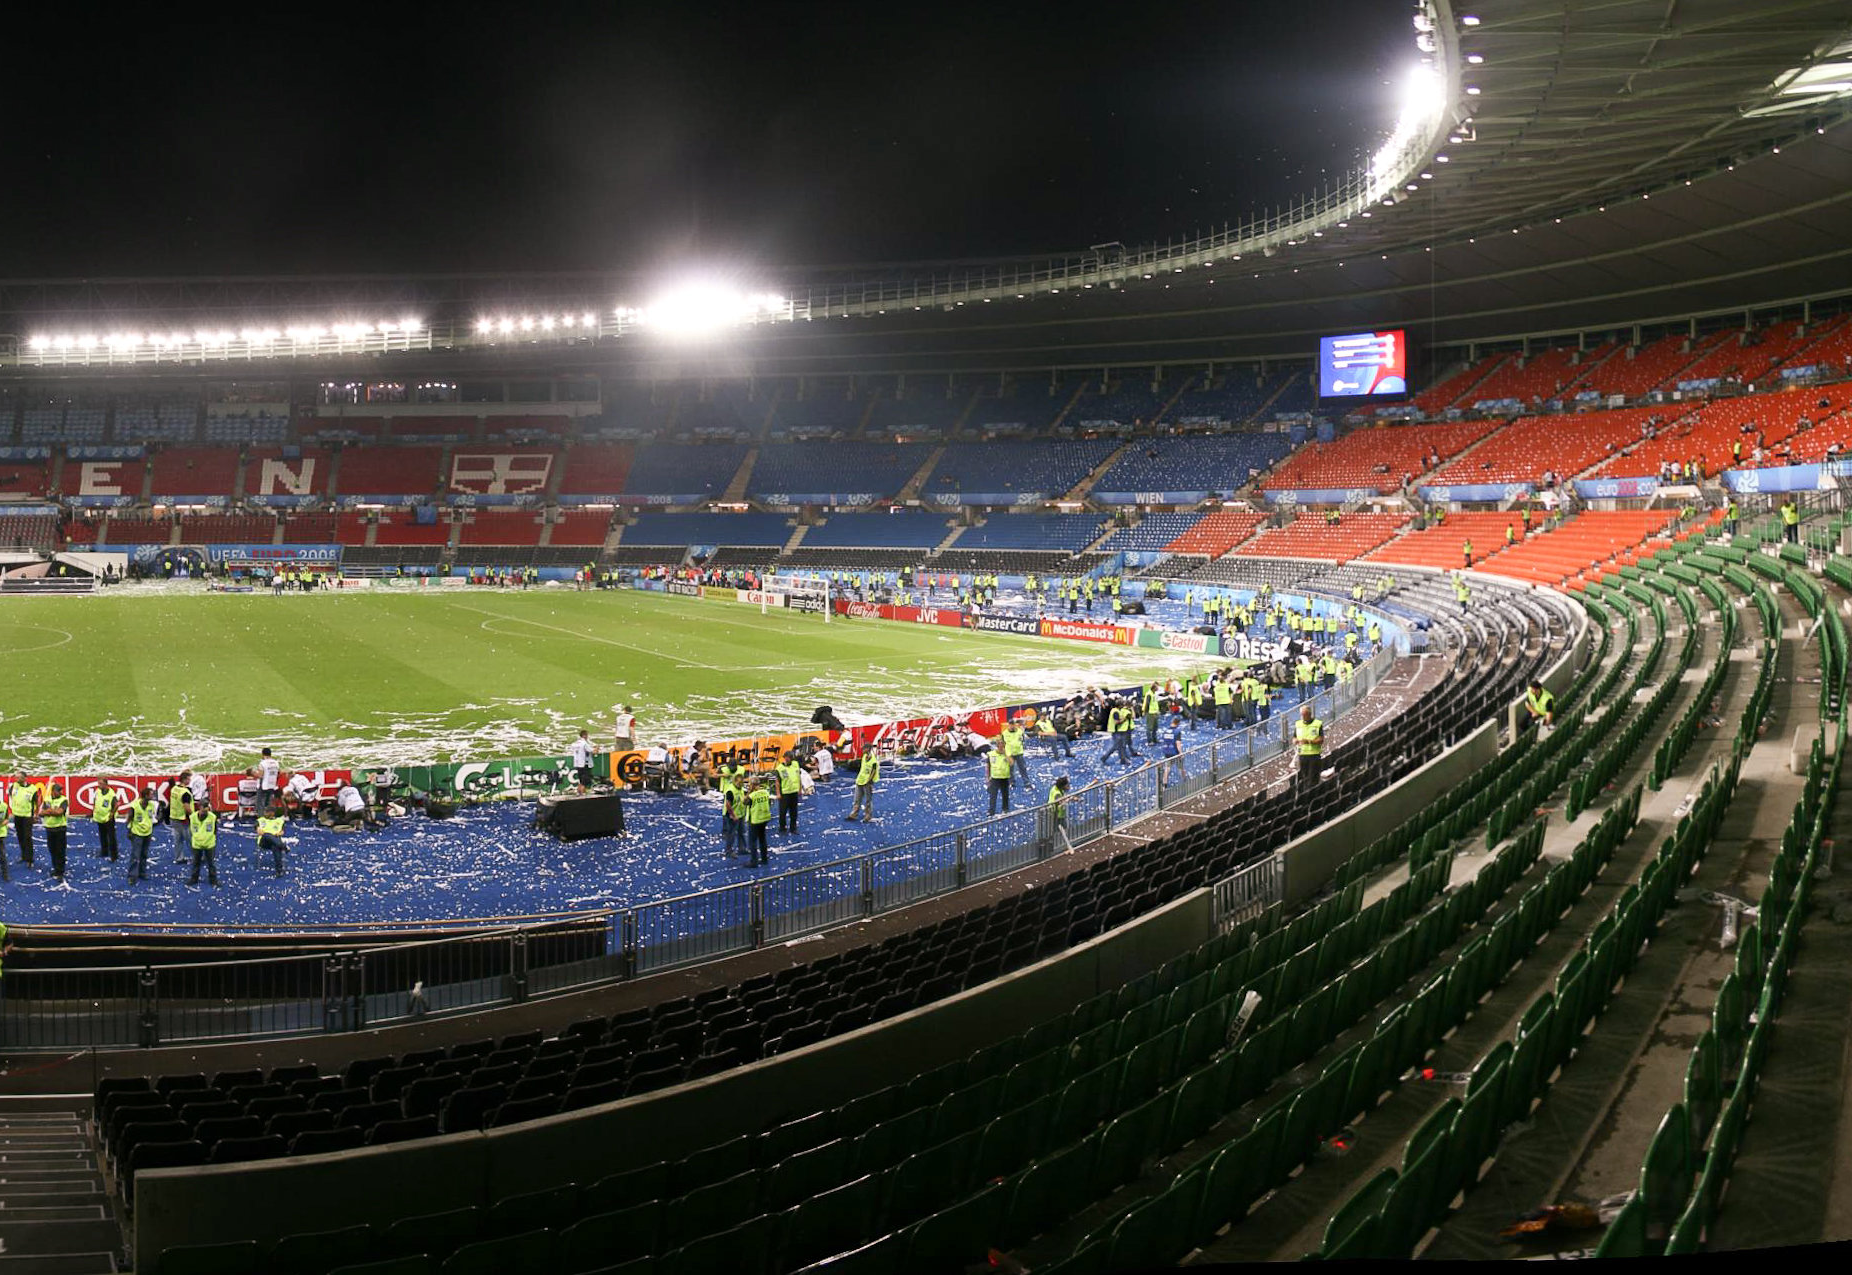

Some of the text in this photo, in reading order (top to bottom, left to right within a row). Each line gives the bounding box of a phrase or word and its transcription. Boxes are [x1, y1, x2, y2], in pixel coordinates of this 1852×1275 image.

[1596, 479, 1658, 497] euro.com
[593, 496, 617, 504] UEFA
[648, 495, 672, 504] 2008
[1135, 492, 1165, 504] WIEN
[211, 549, 337, 562] UEFA EURO 2008
[805, 599, 826, 610] adid
[917, 609, 938, 624] JVC
[979, 614, 1037, 633] MasterCard
[1053, 624, 1114, 641] McDonald's
[1171, 635, 1204, 651] Castrol
[88, 787, 130, 803] KA
